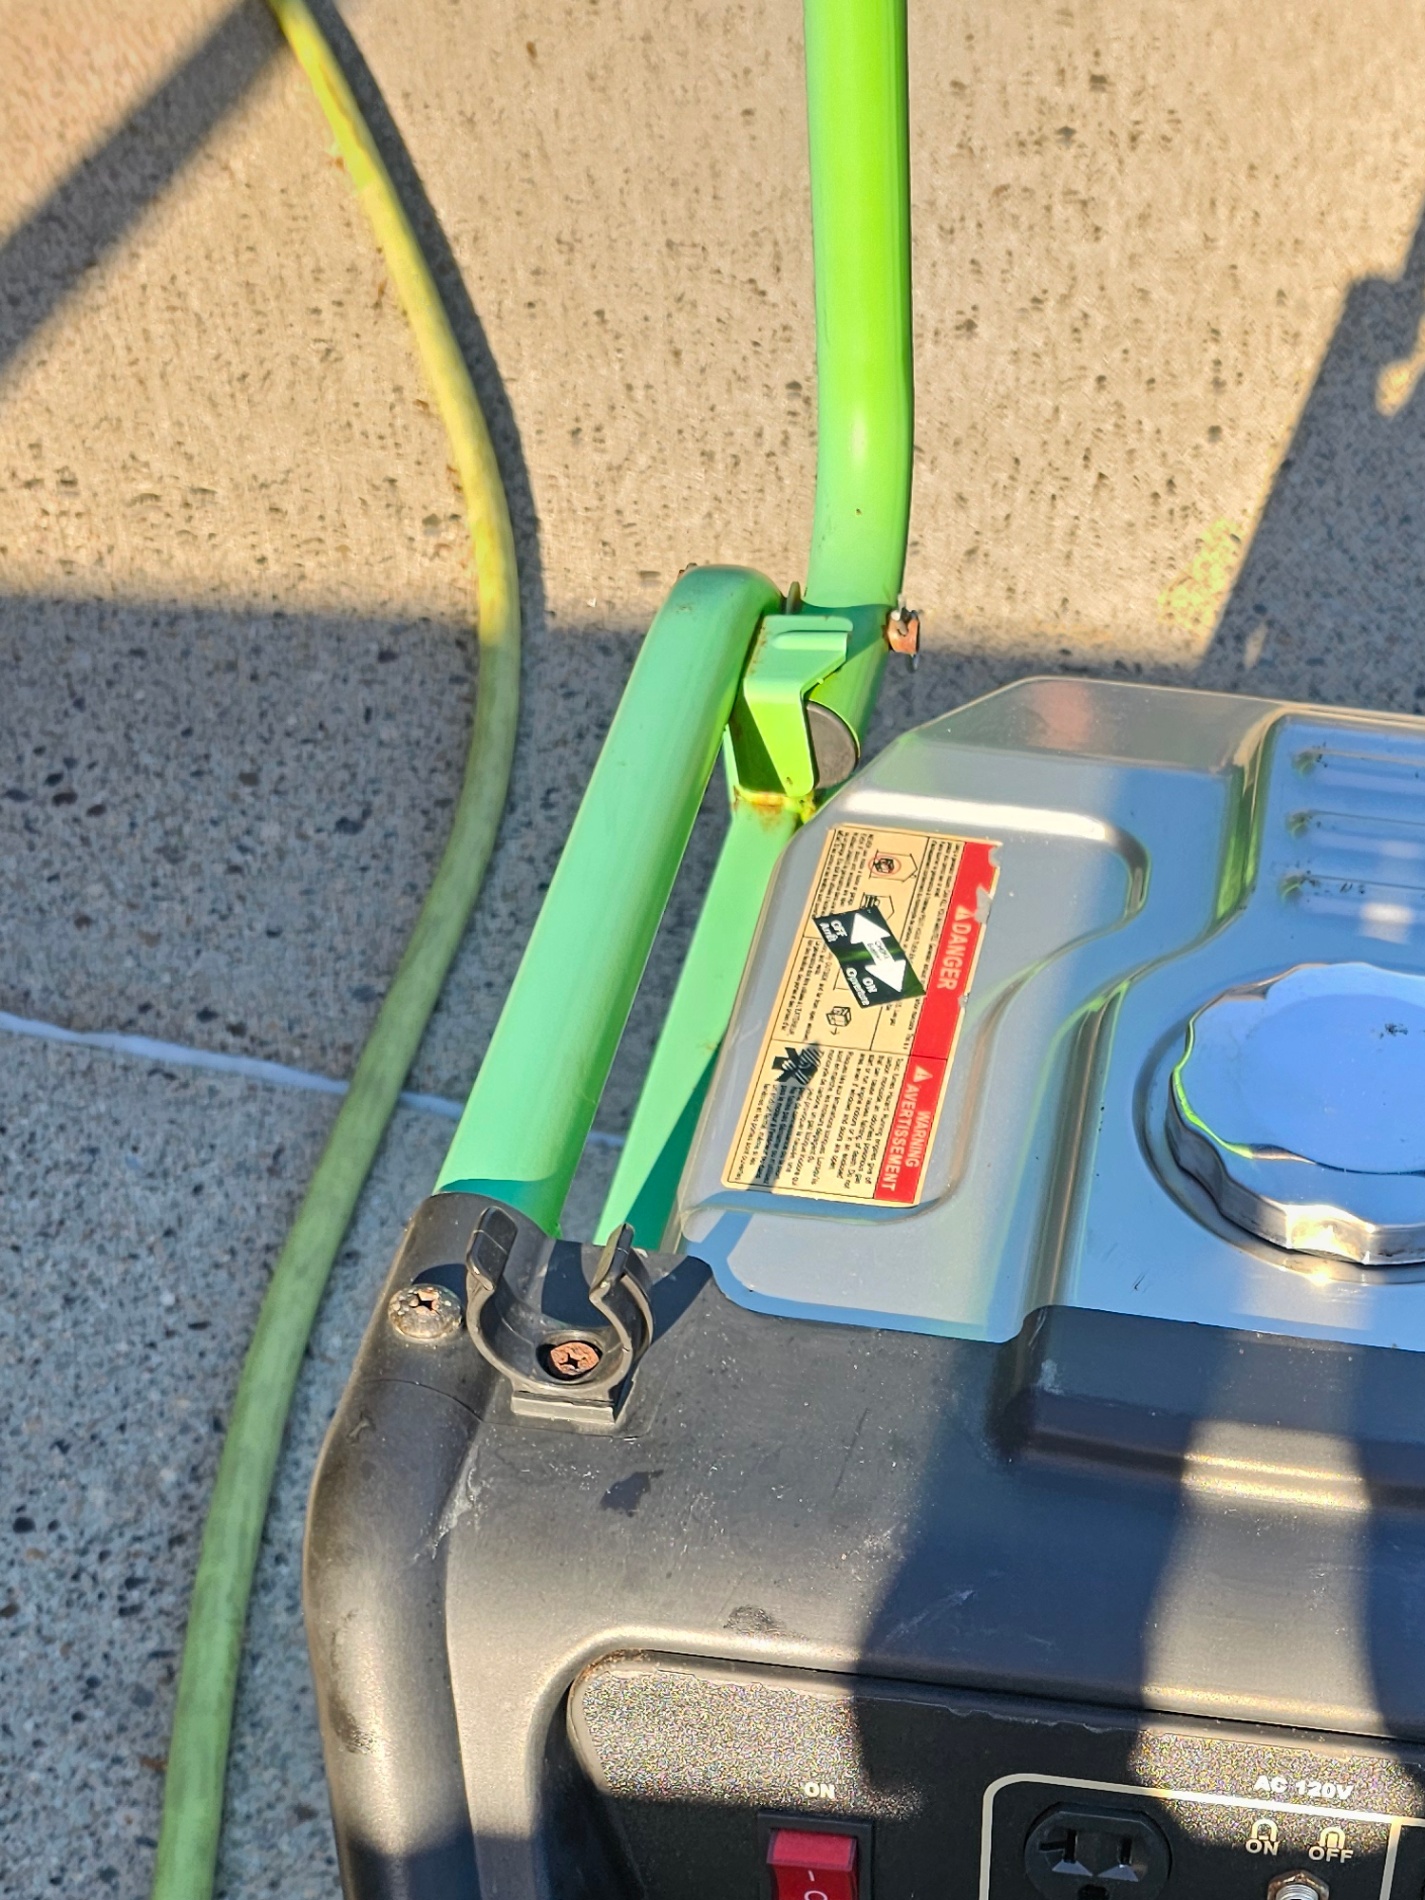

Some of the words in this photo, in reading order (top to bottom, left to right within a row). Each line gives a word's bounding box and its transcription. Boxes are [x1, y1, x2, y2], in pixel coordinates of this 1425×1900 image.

[828, 919, 848, 937] OFF
[937, 922, 970, 990] DANGER
[860, 976, 879, 994] ON
[880, 1083, 919, 1191] AVERTISSEMENT
[904, 1109, 932, 1167] WARNING
[804, 1782, 835, 1799] ON
[1254, 1776, 1287, 1792] AC
[1295, 1780, 1354, 1799] 120V
[1245, 1838, 1279, 1856] ON
[1308, 1846, 1353, 1863] OFF
